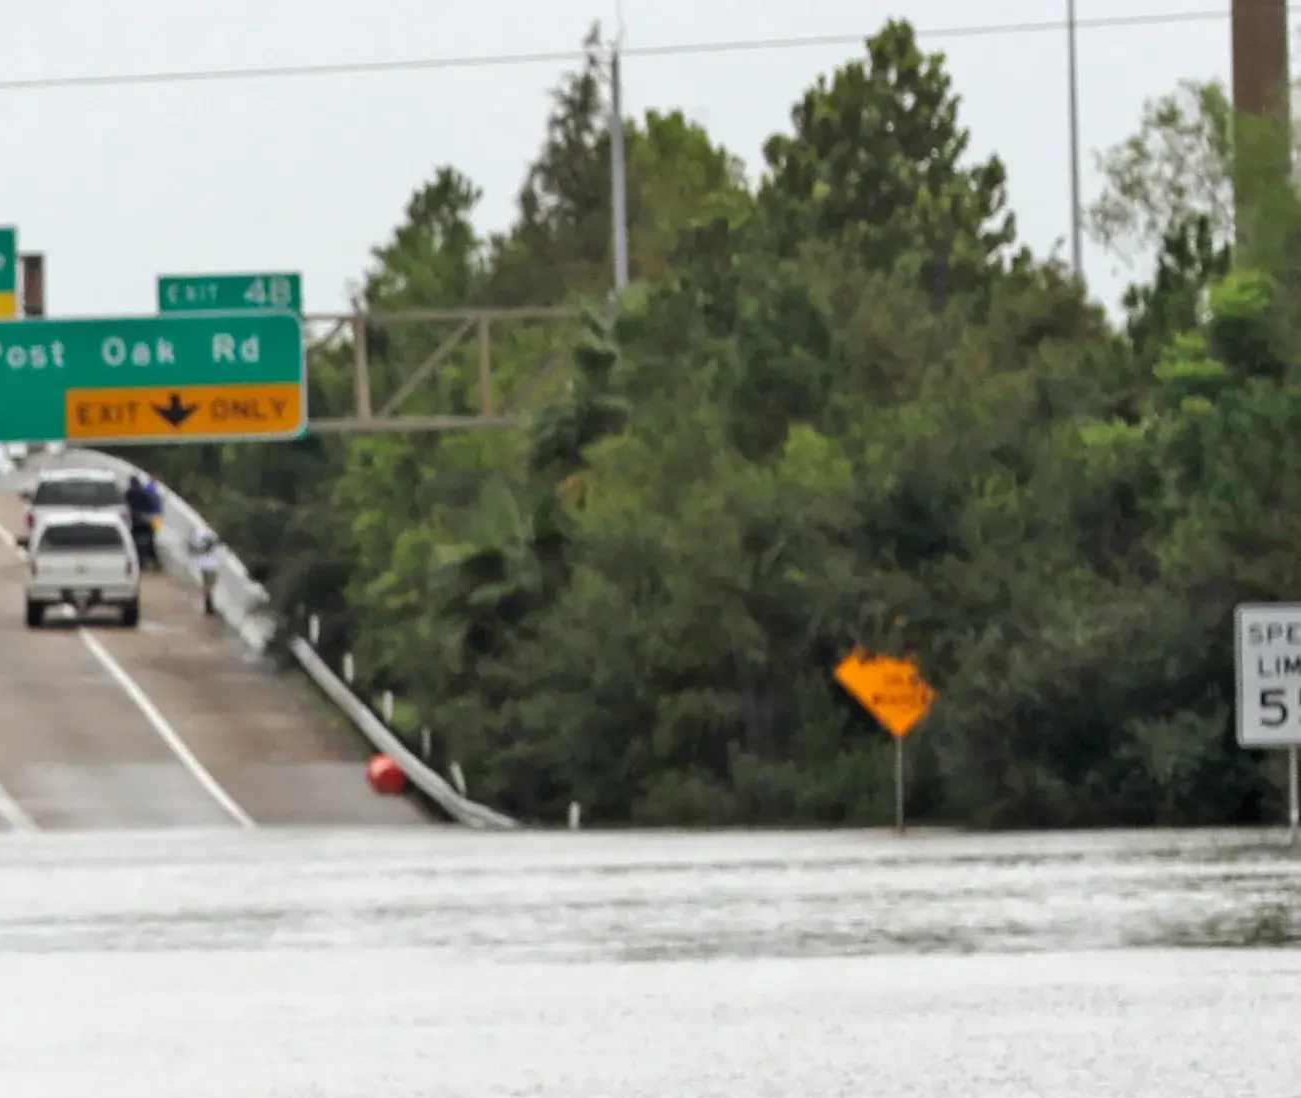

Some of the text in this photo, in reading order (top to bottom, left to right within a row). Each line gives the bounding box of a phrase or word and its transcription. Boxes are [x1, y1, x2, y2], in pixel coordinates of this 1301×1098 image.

[166, 282, 219, 305] EXIT
[101, 335, 177, 367] Oak
[212, 331, 262, 364] Rd
[75, 396, 288, 428] EXIT ONLY
[1247, 621, 1301, 646] SPE
[1258, 654, 1301, 678] LIM
[1259, 686, 1301, 729] 5
